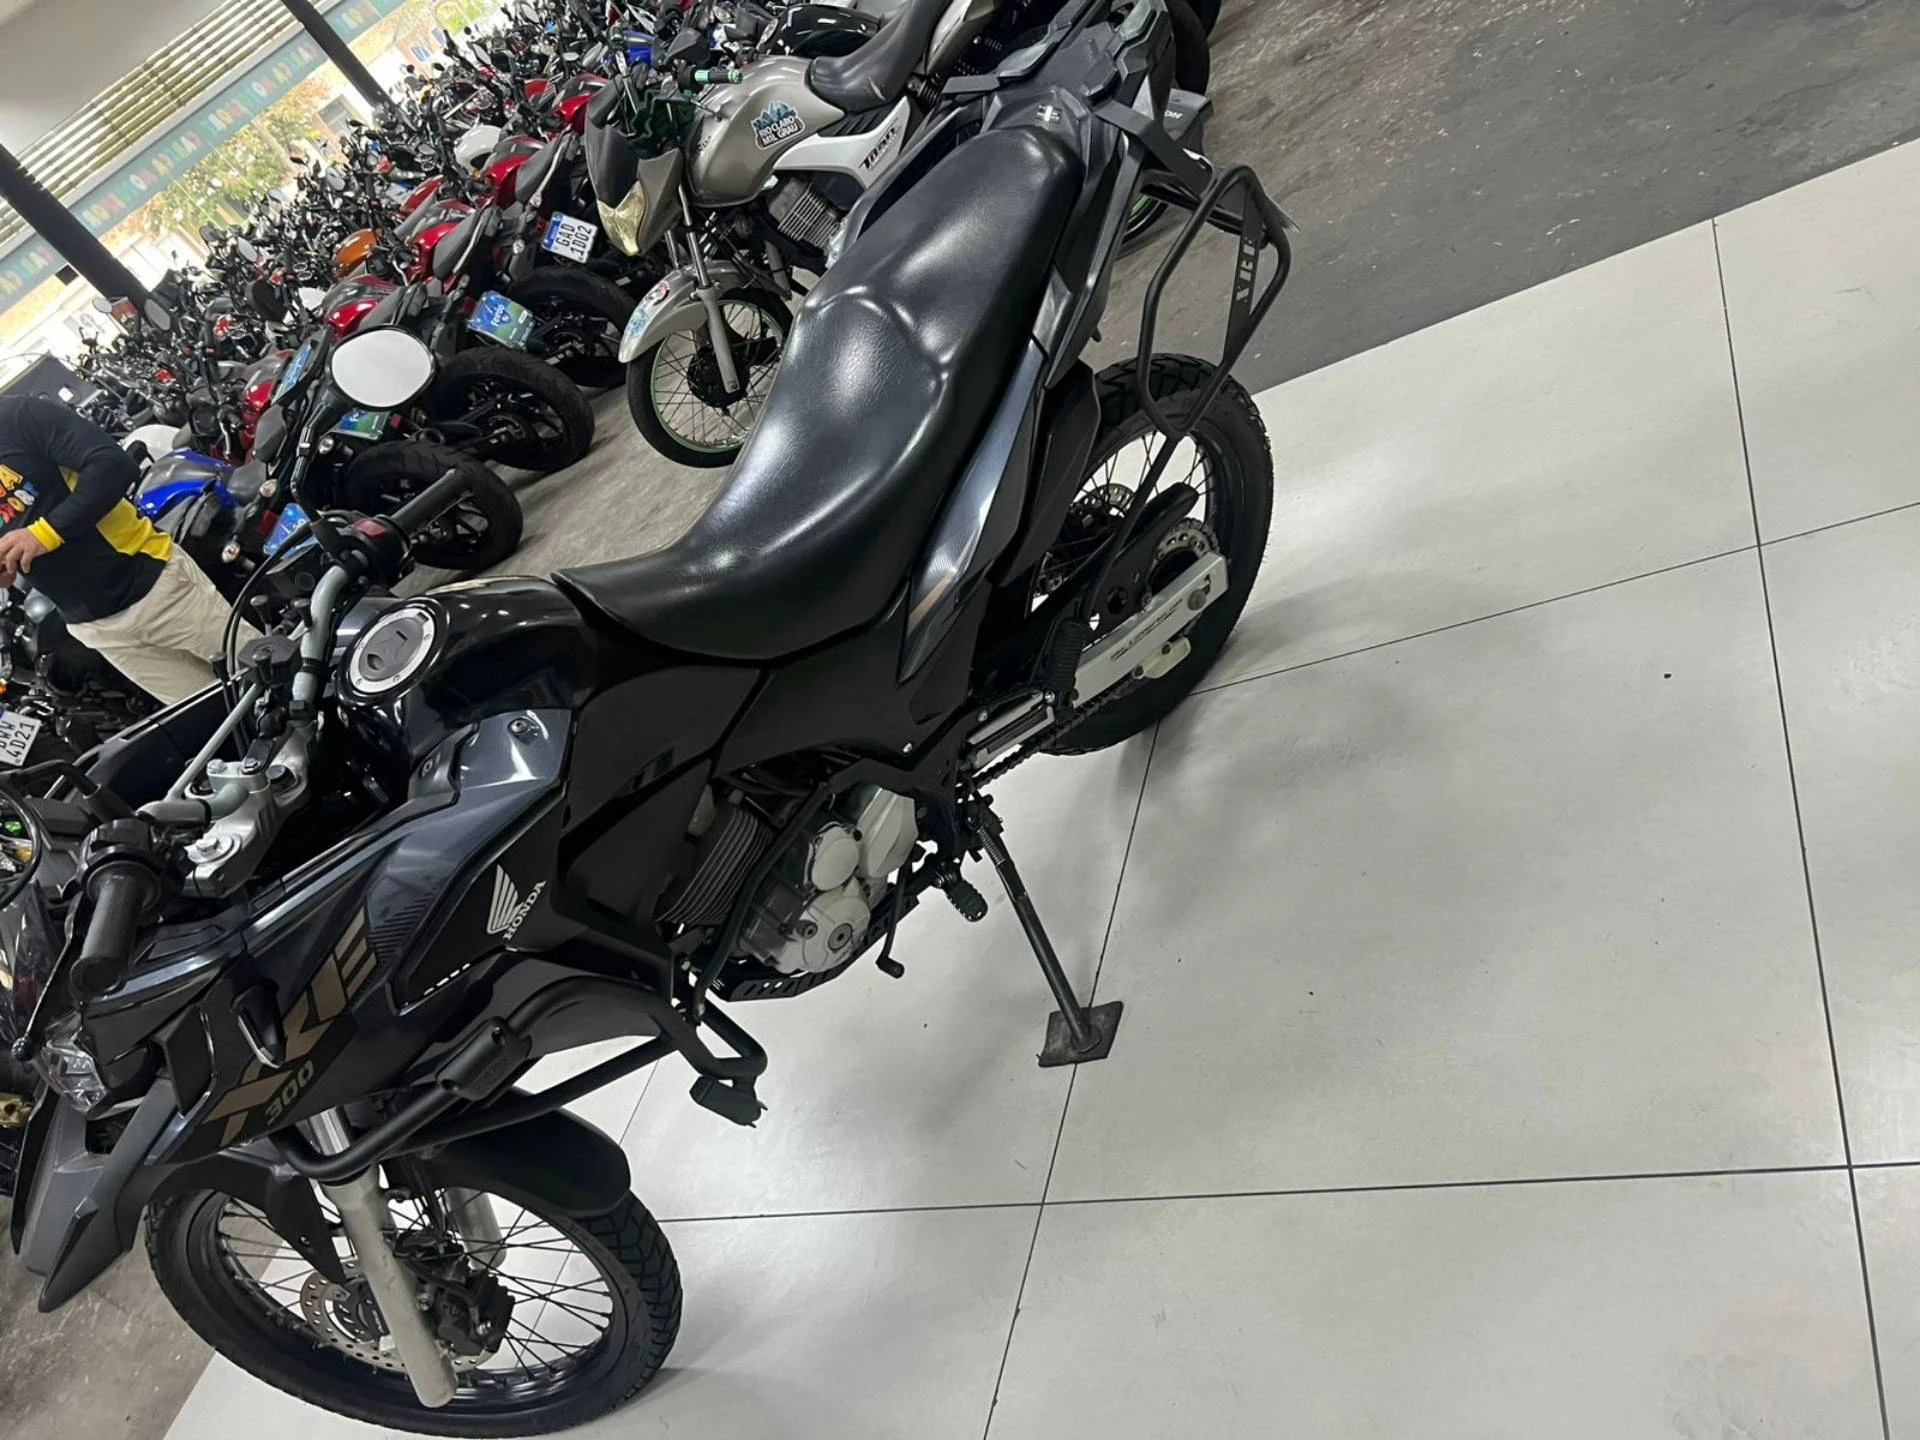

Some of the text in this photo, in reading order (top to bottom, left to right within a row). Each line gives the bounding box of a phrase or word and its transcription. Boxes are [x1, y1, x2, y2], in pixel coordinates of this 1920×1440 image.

[556, 223, 575, 247] GAD
[570, 225, 592, 256] 1002
[6, 722, 35, 757] 4D21
[502, 881, 546, 940] HONDA
[265, 1060, 314, 1125] 300
